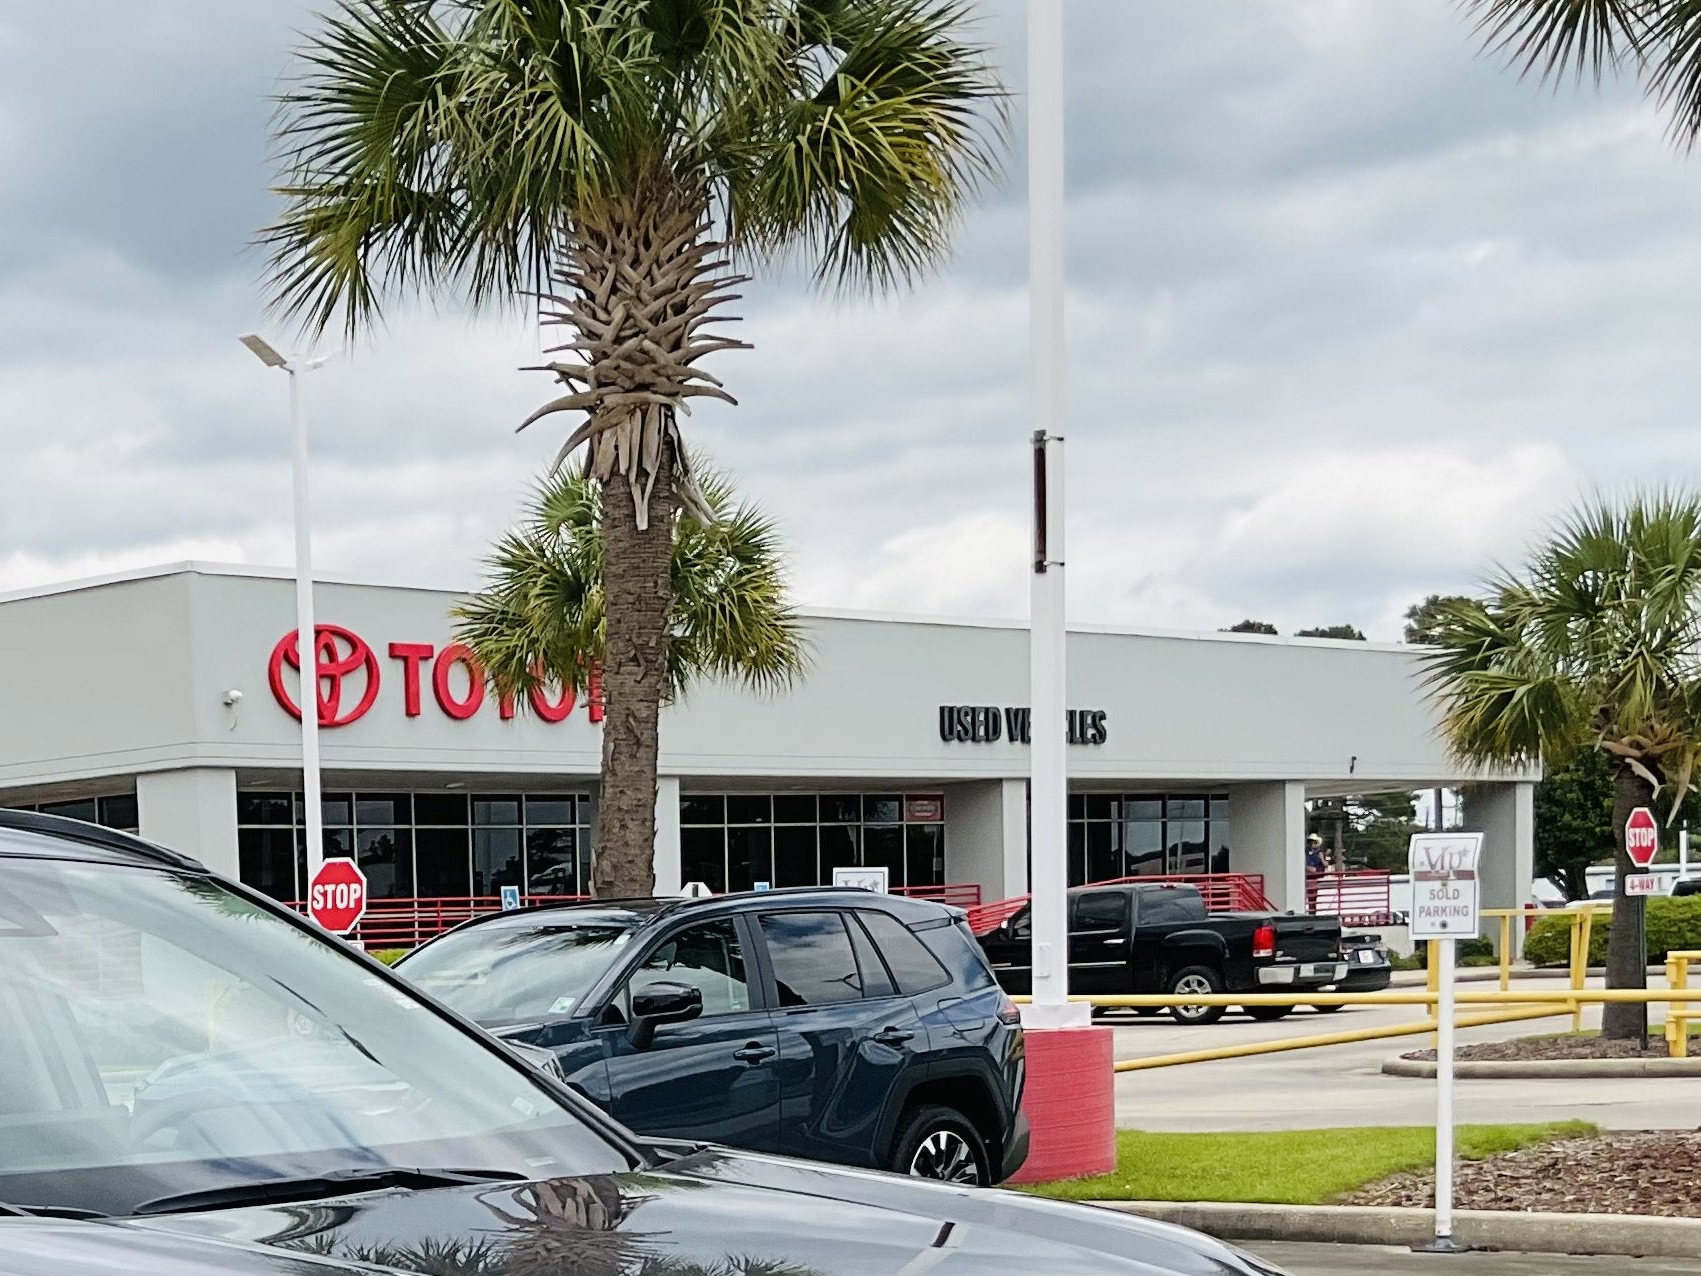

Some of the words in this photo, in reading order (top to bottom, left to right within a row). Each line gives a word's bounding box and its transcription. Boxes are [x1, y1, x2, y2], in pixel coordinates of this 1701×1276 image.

[388, 642, 605, 722] TOO
[939, 705, 1002, 743] USED
[1005, 707, 1107, 745] VELES
[1628, 827, 1655, 848] STOP
[1429, 888, 1460, 901] SOLD
[1629, 877, 1655, 891] 4-WAY
[312, 882, 362, 911] STOP
[1418, 905, 1469, 918] PARKING
